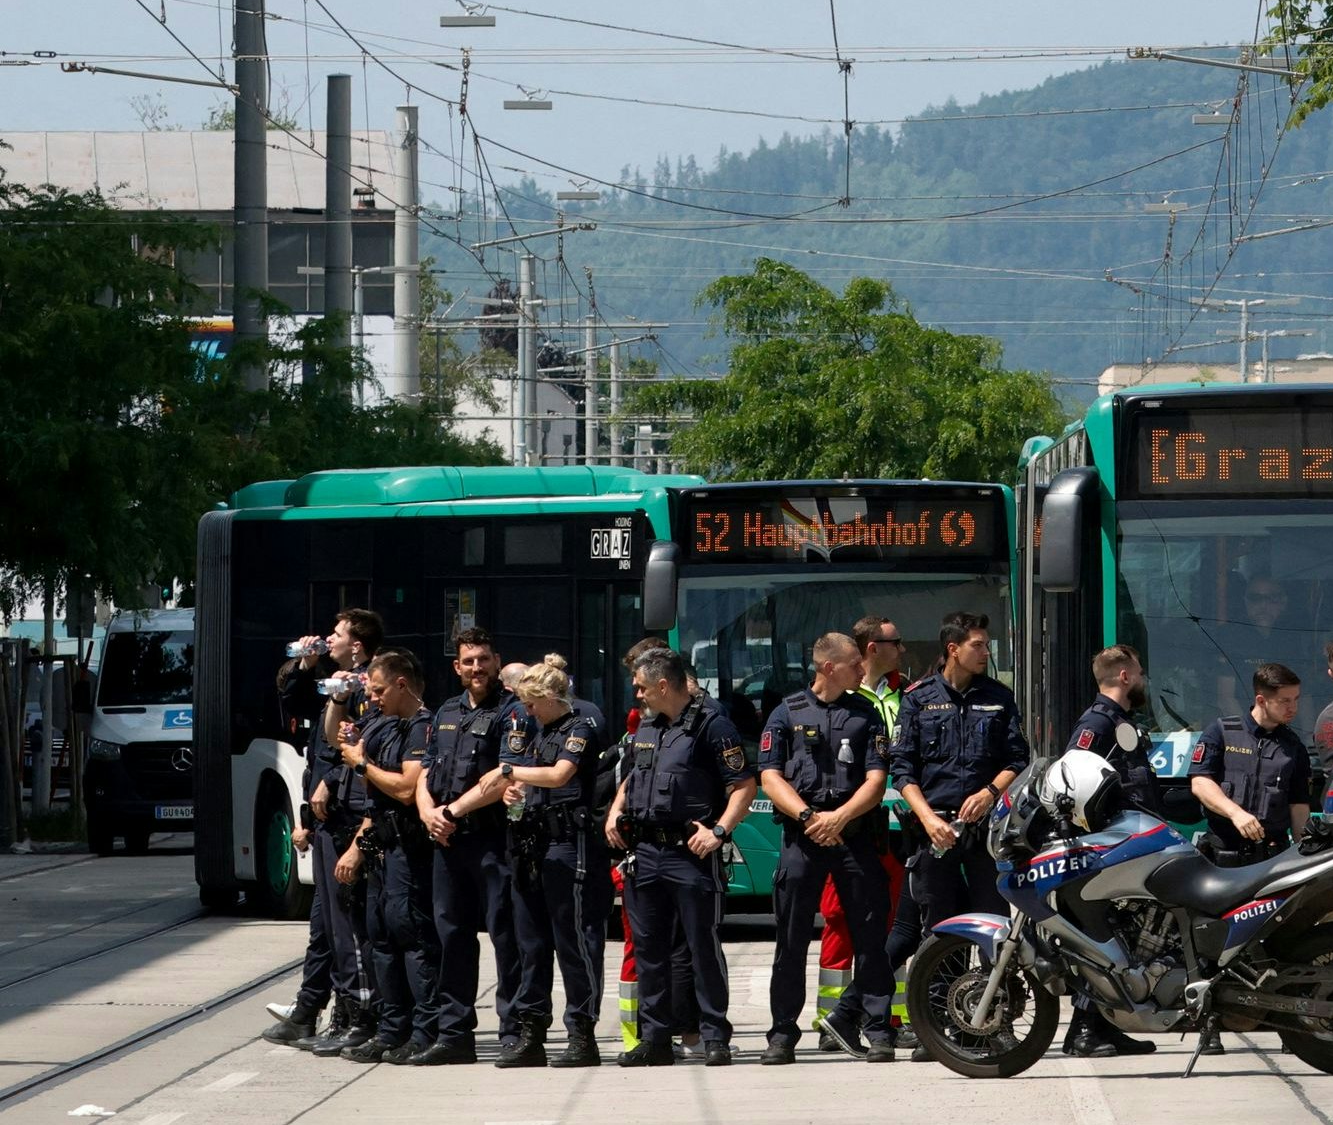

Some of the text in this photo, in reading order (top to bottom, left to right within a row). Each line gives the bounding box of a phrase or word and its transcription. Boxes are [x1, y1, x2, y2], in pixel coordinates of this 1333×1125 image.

[591, 531, 631, 557] GRAZ
[695, 511, 930, 552] 52 Hauptbahnhof
[1225, 745, 1253, 755] POLIZEI
[1017, 854, 1088, 887] POLIZEI
[1234, 900, 1278, 923] POLIZEI
